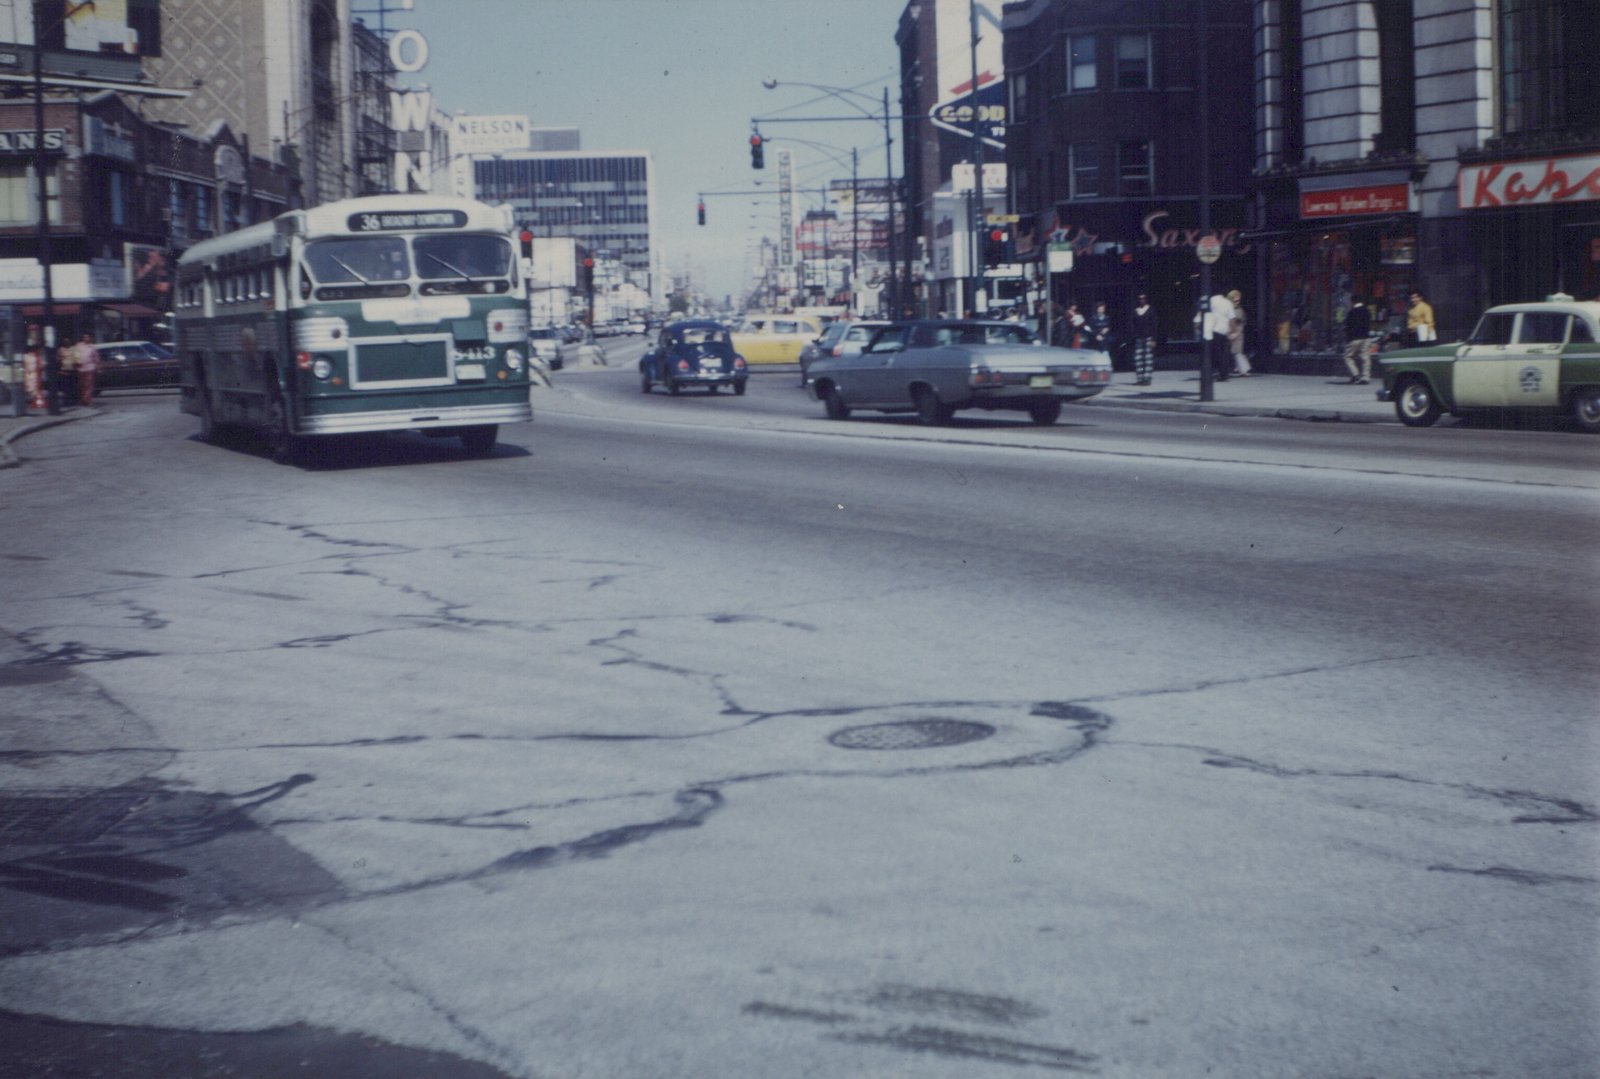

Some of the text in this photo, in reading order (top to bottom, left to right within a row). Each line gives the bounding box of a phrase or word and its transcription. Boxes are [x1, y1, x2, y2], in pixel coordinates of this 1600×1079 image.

[389, 0, 431, 192] OWN
[459, 121, 524, 134] NELSON
[361, 214, 380, 231] 36
[1142, 210, 1251, 255] Saxny
